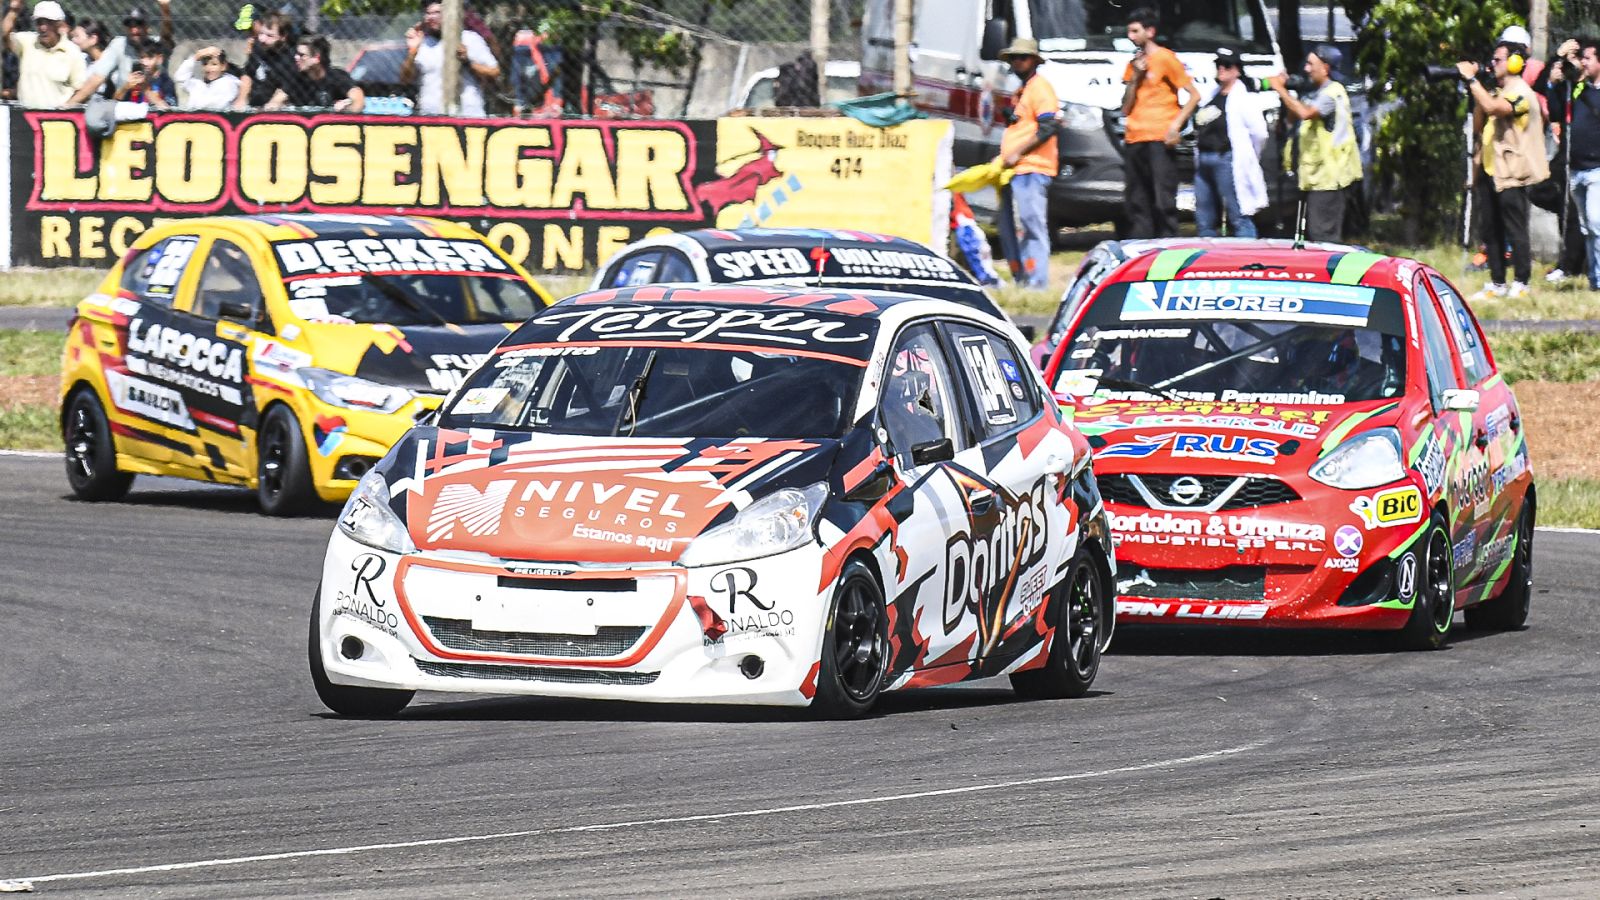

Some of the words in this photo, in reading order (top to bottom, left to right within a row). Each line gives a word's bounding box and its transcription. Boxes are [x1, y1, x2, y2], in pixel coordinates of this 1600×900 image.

[41, 120, 224, 203] LEO
[240, 123, 691, 211] OSENGAR
[831, 157, 862, 178] 474
[276, 238, 507, 273] DECKER
[713, 247, 811, 279] SPEED
[829, 247, 954, 273] UNLIMITED
[1181, 280, 1231, 295] LAB
[1174, 295, 1305, 313] NEORED
[533, 304, 870, 344] Terepin
[127, 317, 243, 384] LAROCCA
[1221, 389, 1345, 405] Pergamino
[1174, 432, 1280, 458] RUS
[520, 480, 686, 519] NIVEL
[1383, 494, 1417, 516] BiC
[514, 506, 677, 532] SEGUROS
[1206, 515, 1226, 536] &
[1229, 515, 1326, 541] Urquiza
[572, 523, 632, 545] Estamos
[1111, 532, 1266, 549] OMBUSTIBLES
[1274, 539, 1325, 552] SRL
[944, 478, 1049, 632] Doritos
[1324, 557, 1360, 569] AXION
[513, 567, 566, 577] PEUGEOT
[710, 566, 776, 614] R
[336, 590, 399, 629] RONALDO
[722, 609, 794, 634] ONALDO
[1116, 602, 1170, 616] AN
[1175, 604, 1270, 619] LUIS
